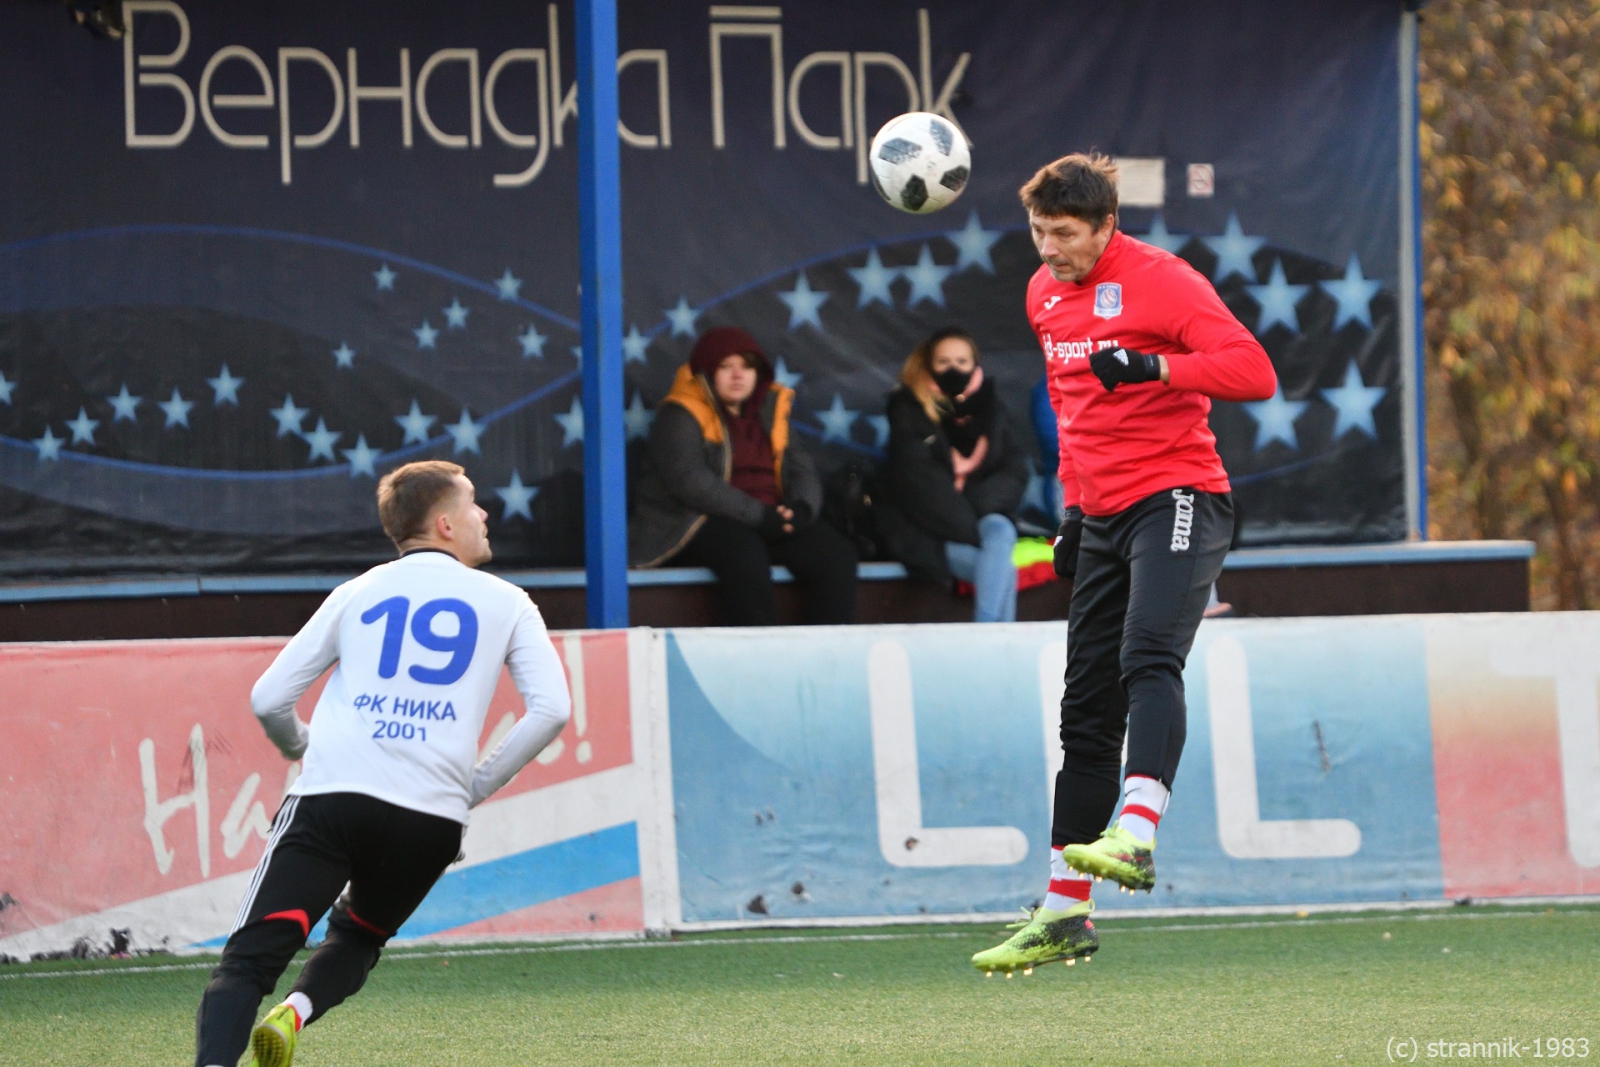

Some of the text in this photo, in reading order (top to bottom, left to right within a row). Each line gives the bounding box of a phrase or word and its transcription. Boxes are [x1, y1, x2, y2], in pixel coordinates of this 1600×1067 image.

[709, 5, 974, 185] Парк
[1171, 488, 1195, 552] Joma
[360, 595, 479, 685] 19
[353, 693, 457, 721] ФК НИКА
[372, 719, 427, 742] 2001
